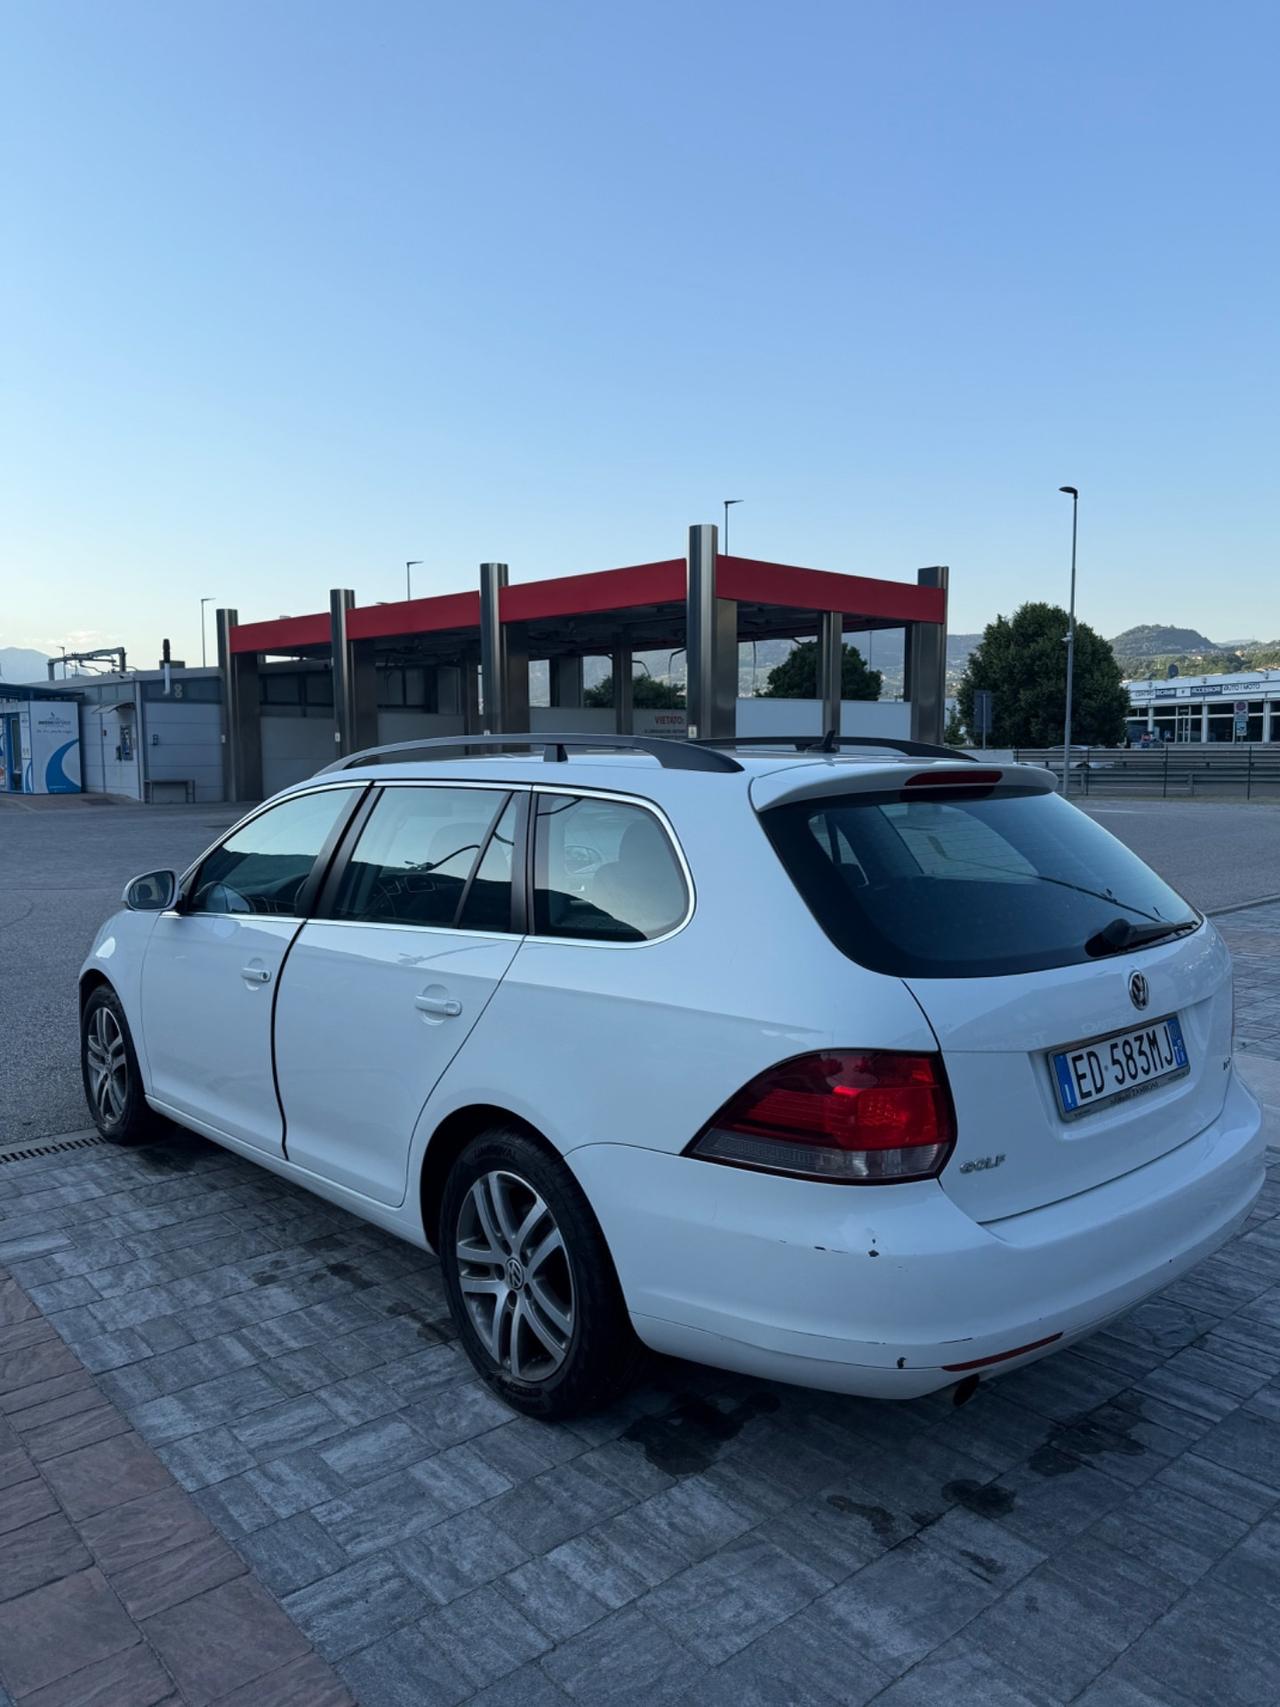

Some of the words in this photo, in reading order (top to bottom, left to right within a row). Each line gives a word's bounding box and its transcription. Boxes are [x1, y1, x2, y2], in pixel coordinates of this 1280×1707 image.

[1071, 1050, 1106, 1100] ED
[1109, 1025, 1174, 1086] 583MJ
[960, 1153, 1007, 1174] GOLF
